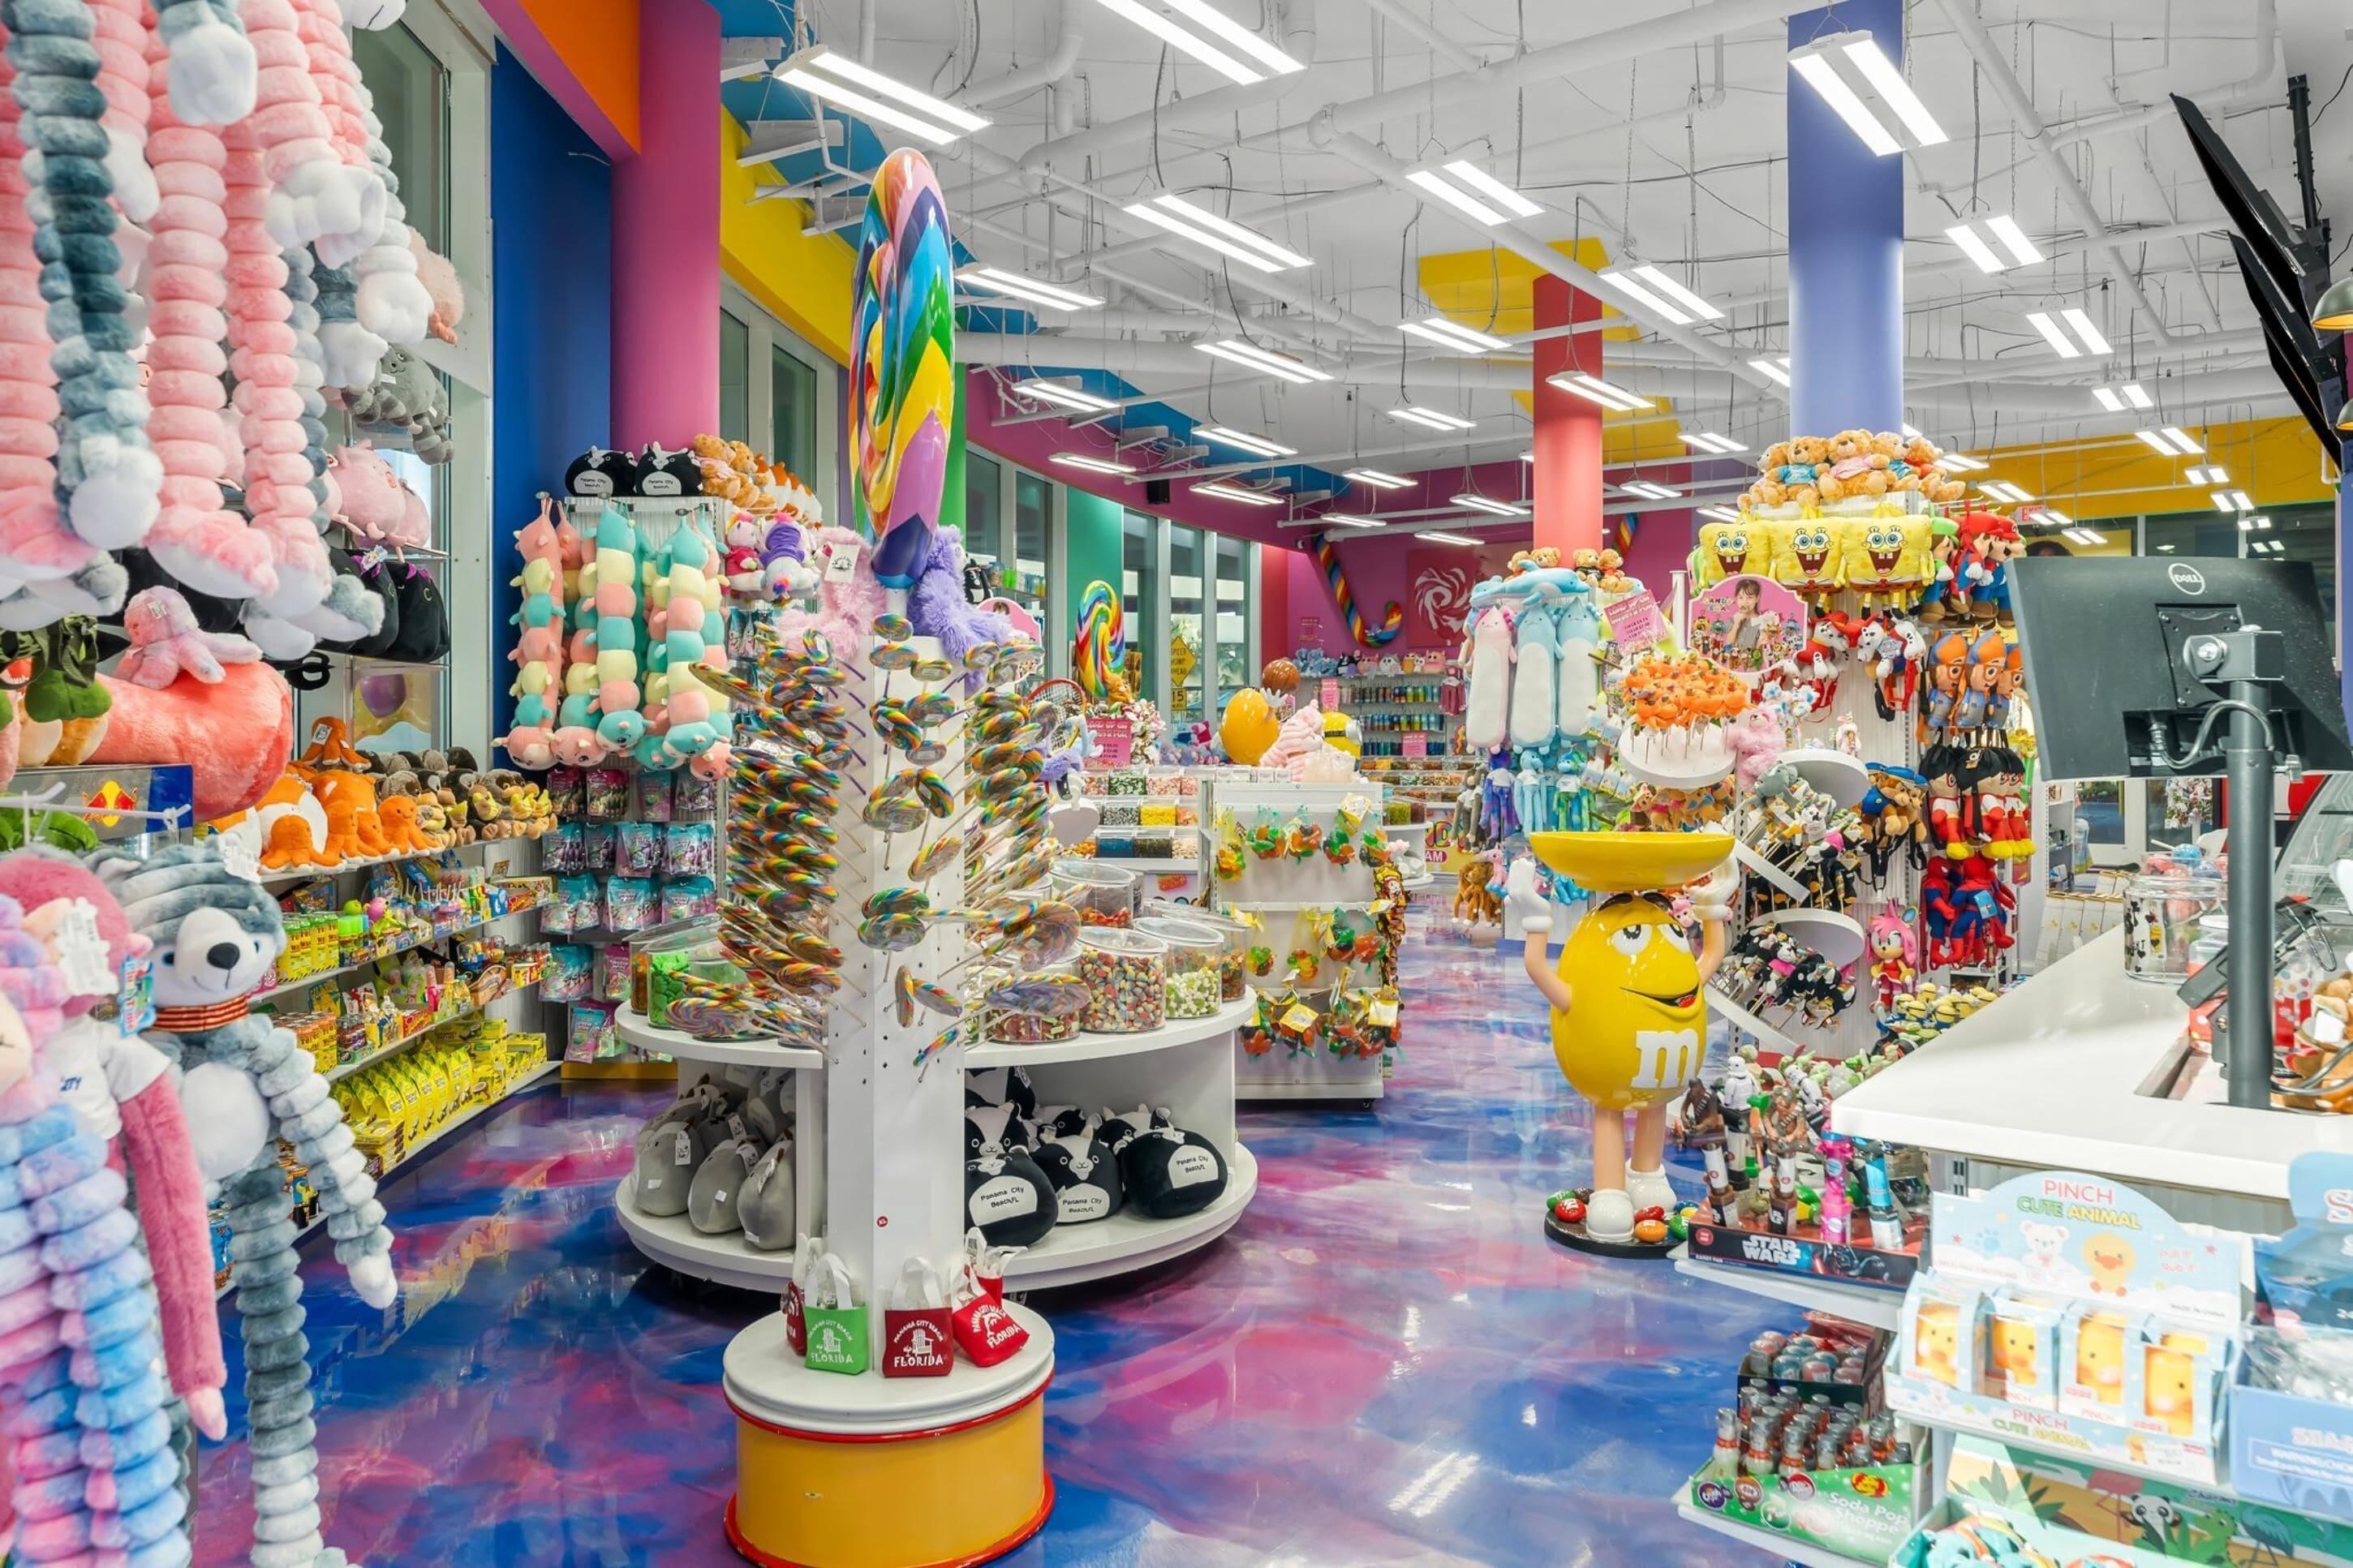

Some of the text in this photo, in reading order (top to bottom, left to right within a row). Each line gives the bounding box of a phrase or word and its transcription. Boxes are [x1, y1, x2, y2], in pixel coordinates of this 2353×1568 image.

[2174, 574, 2201, 583] DELL
[1172, 690, 1184, 702] 15
[1176, 1157, 1197, 1166] Panama
[980, 1189, 1008, 1201] Panama
[2044, 1179, 2114, 1205] PINCH
[2018, 1196, 2142, 1231] CUTE ANIMAL
[1743, 1235, 1797, 1253] STAR
[1744, 1244, 1800, 1265] WARS
[893, 1319, 944, 1344] PANAMA CITY BEACH
[987, 1324, 1022, 1350] FLORIDA
[811, 1353, 854, 1364] FLORIDA
[893, 1353, 945, 1368] FLORIDA
[2012, 1408, 2069, 1431] PINCH
[1992, 1418, 2092, 1451] CUTE ANIMAL
[1830, 1492, 1908, 1526] Soda Pop
[1834, 1506, 1901, 1535] Shoppe
